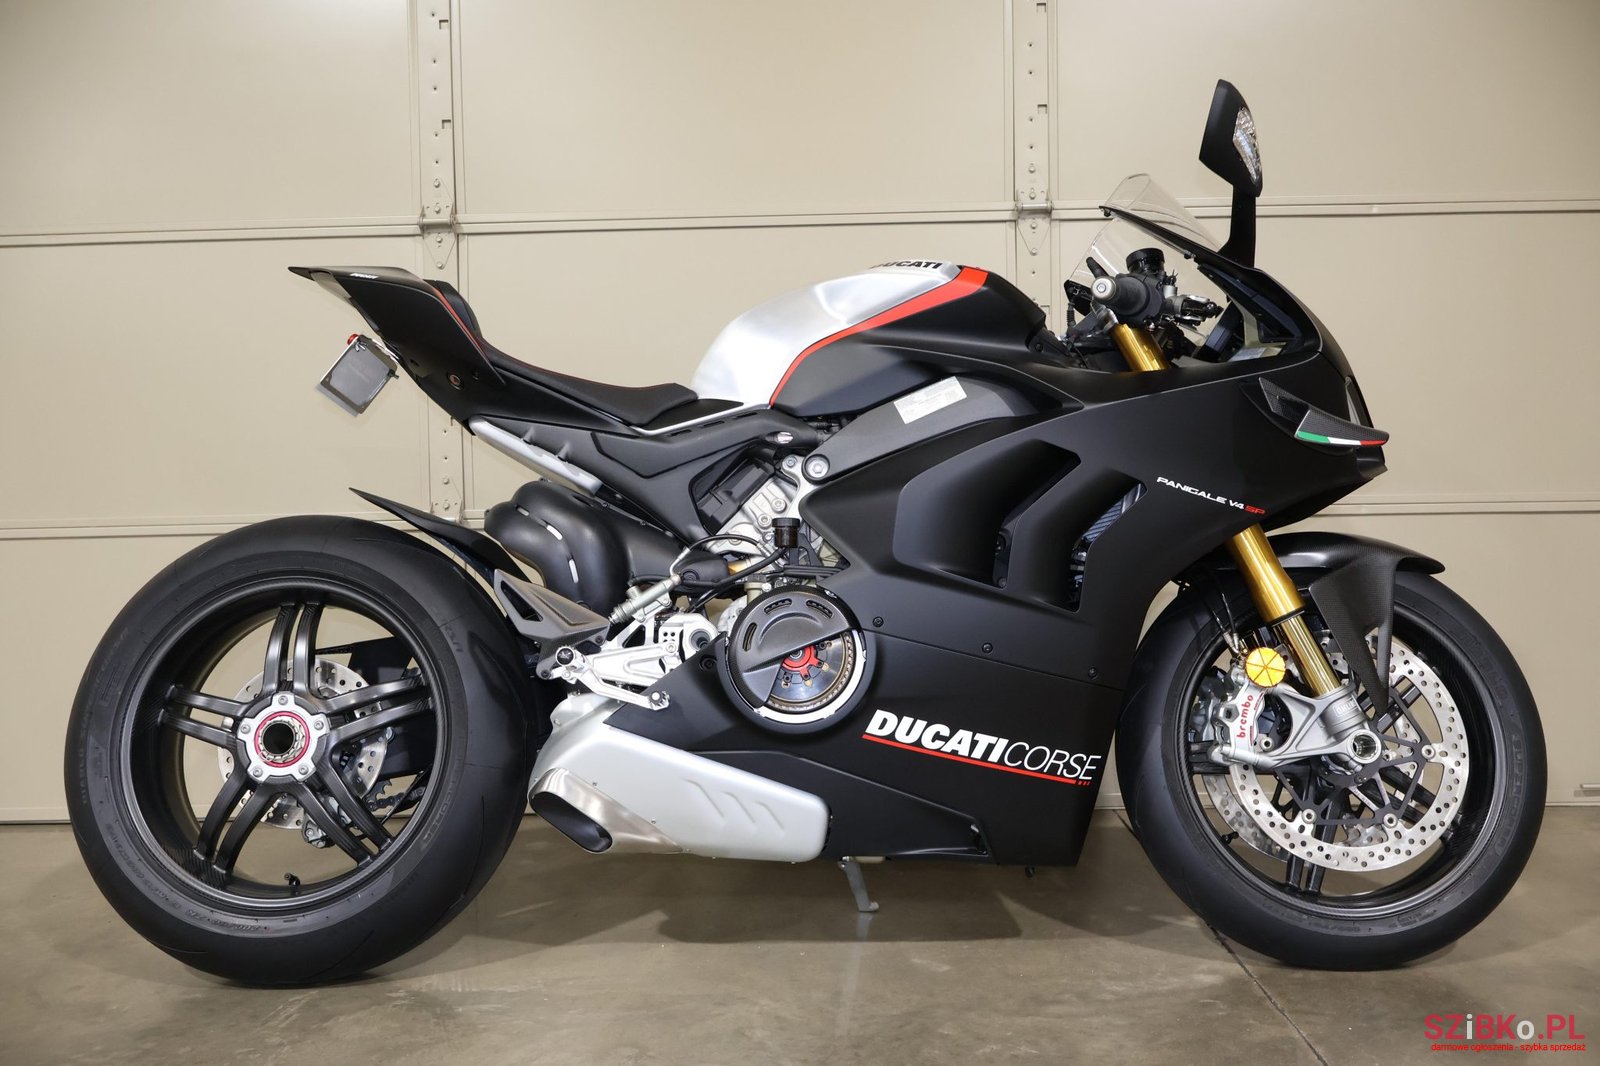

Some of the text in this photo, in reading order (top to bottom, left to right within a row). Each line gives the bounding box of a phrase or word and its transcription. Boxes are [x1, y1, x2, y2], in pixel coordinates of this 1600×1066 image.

[1156, 476, 1228, 505] PANIGALE
[1236, 694, 1254, 739] brembo
[864, 709, 1102, 781] DUCATI CORSE
